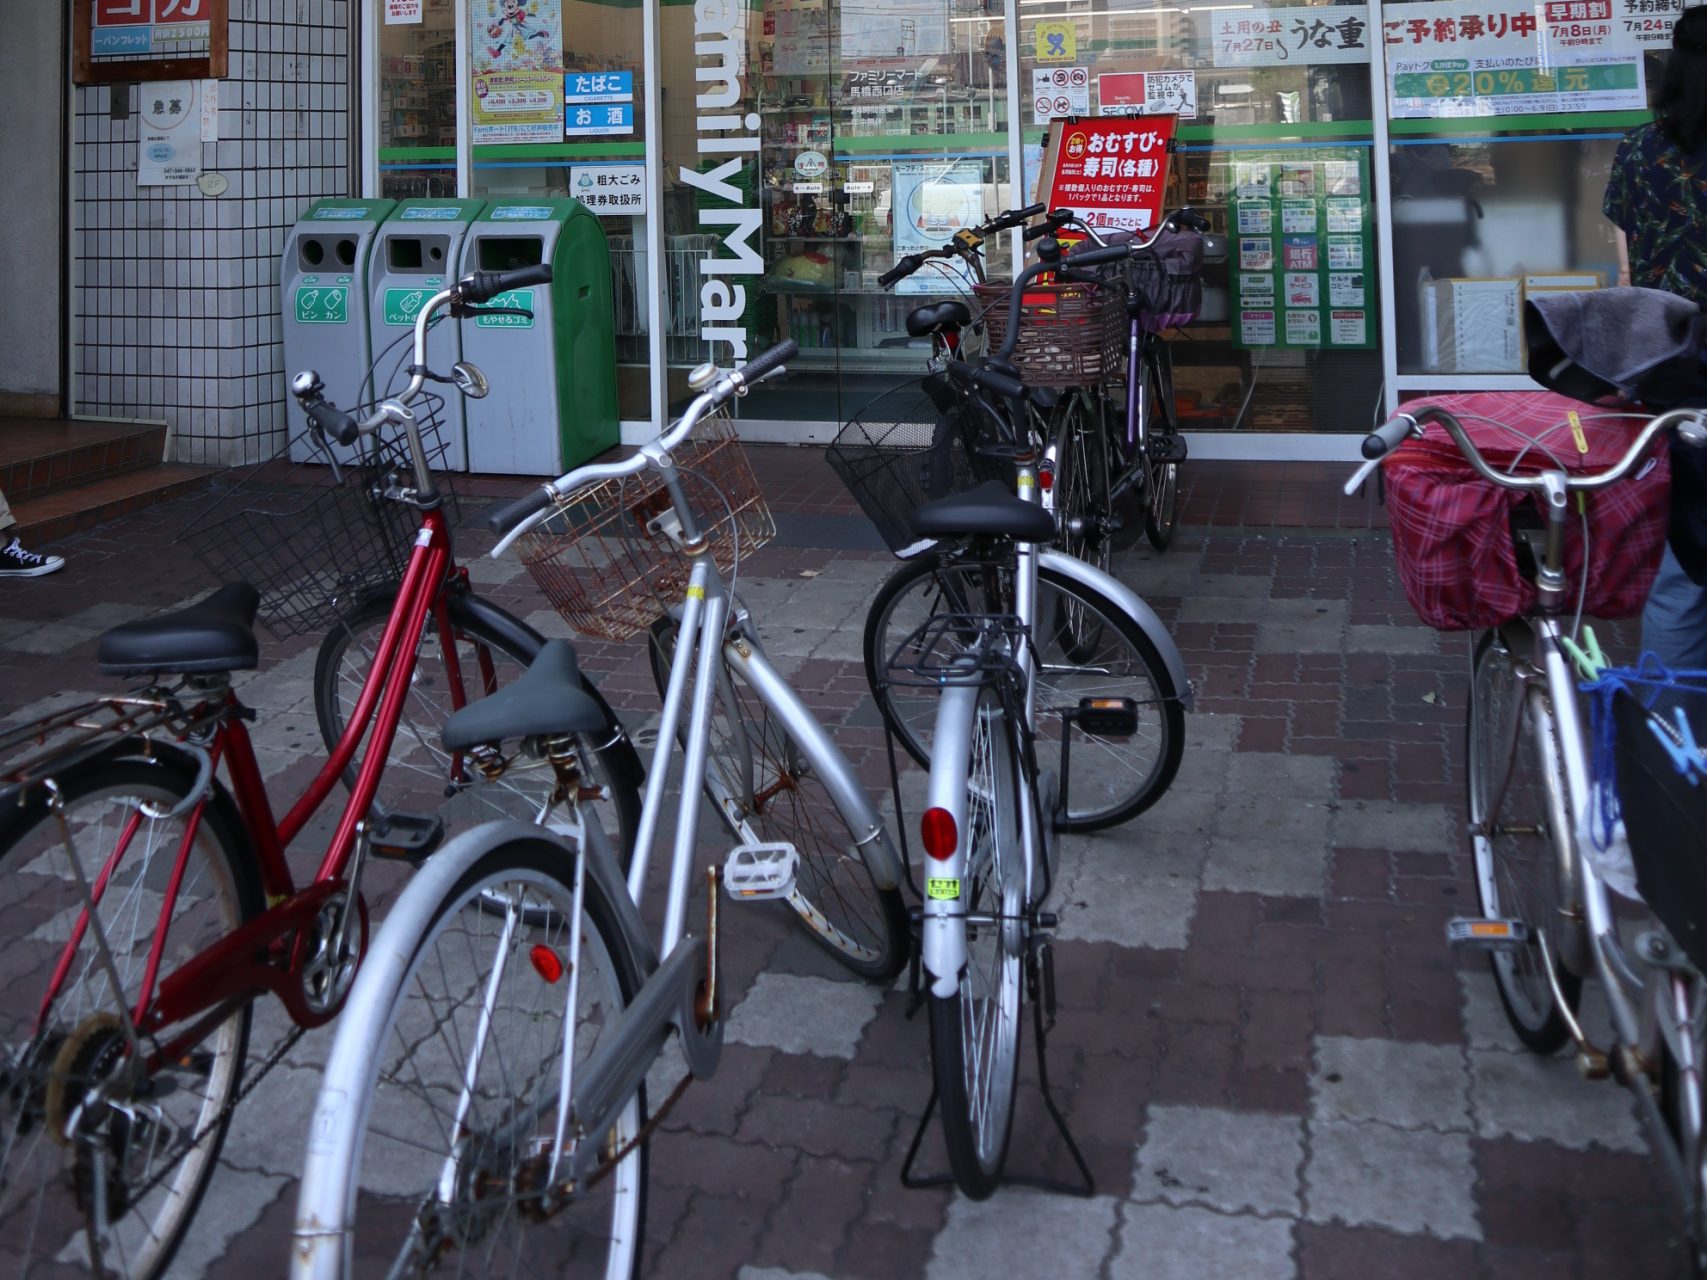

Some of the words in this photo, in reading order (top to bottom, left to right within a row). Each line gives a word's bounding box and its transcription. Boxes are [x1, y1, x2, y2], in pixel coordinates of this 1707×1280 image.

[1551, 1, 1607, 19] 早期割
[1384, 11, 1537, 44] ご予約承り中
[1623, 19, 1674, 33] 7月24日
[1219, 20, 1283, 36] 土用の丑
[1290, 16, 1366, 50] うな重
[1635, 32, 1674, 42] 午前9時ま
[1222, 37, 1274, 53] 7月27日
[1559, 37, 1603, 47] 午前9時まで
[849, 68, 923, 85] ファミリーマート
[1147, 74, 1193, 84] 防犯カメラで
[575, 75, 622, 93] たばこ
[1147, 83, 1181, 92] セコムが
[850, 85, 904, 98] 馬橋西口店
[1147, 91, 1175, 100] 監視中
[152, 99, 182, 115] 急募
[1102, 106, 1144, 116] SECOM
[576, 107, 623, 125] お酒
[597, 174, 641, 186] 粗大ごみ
[575, 193, 642, 206] 処理券取扱所
[1289, 260, 1312, 269] ATM
[301, 311, 318, 320] ビン
[324, 311, 342, 320] カン
[388, 313, 417, 322] ペットボ
[483, 315, 528, 325] もやせるゴミ
